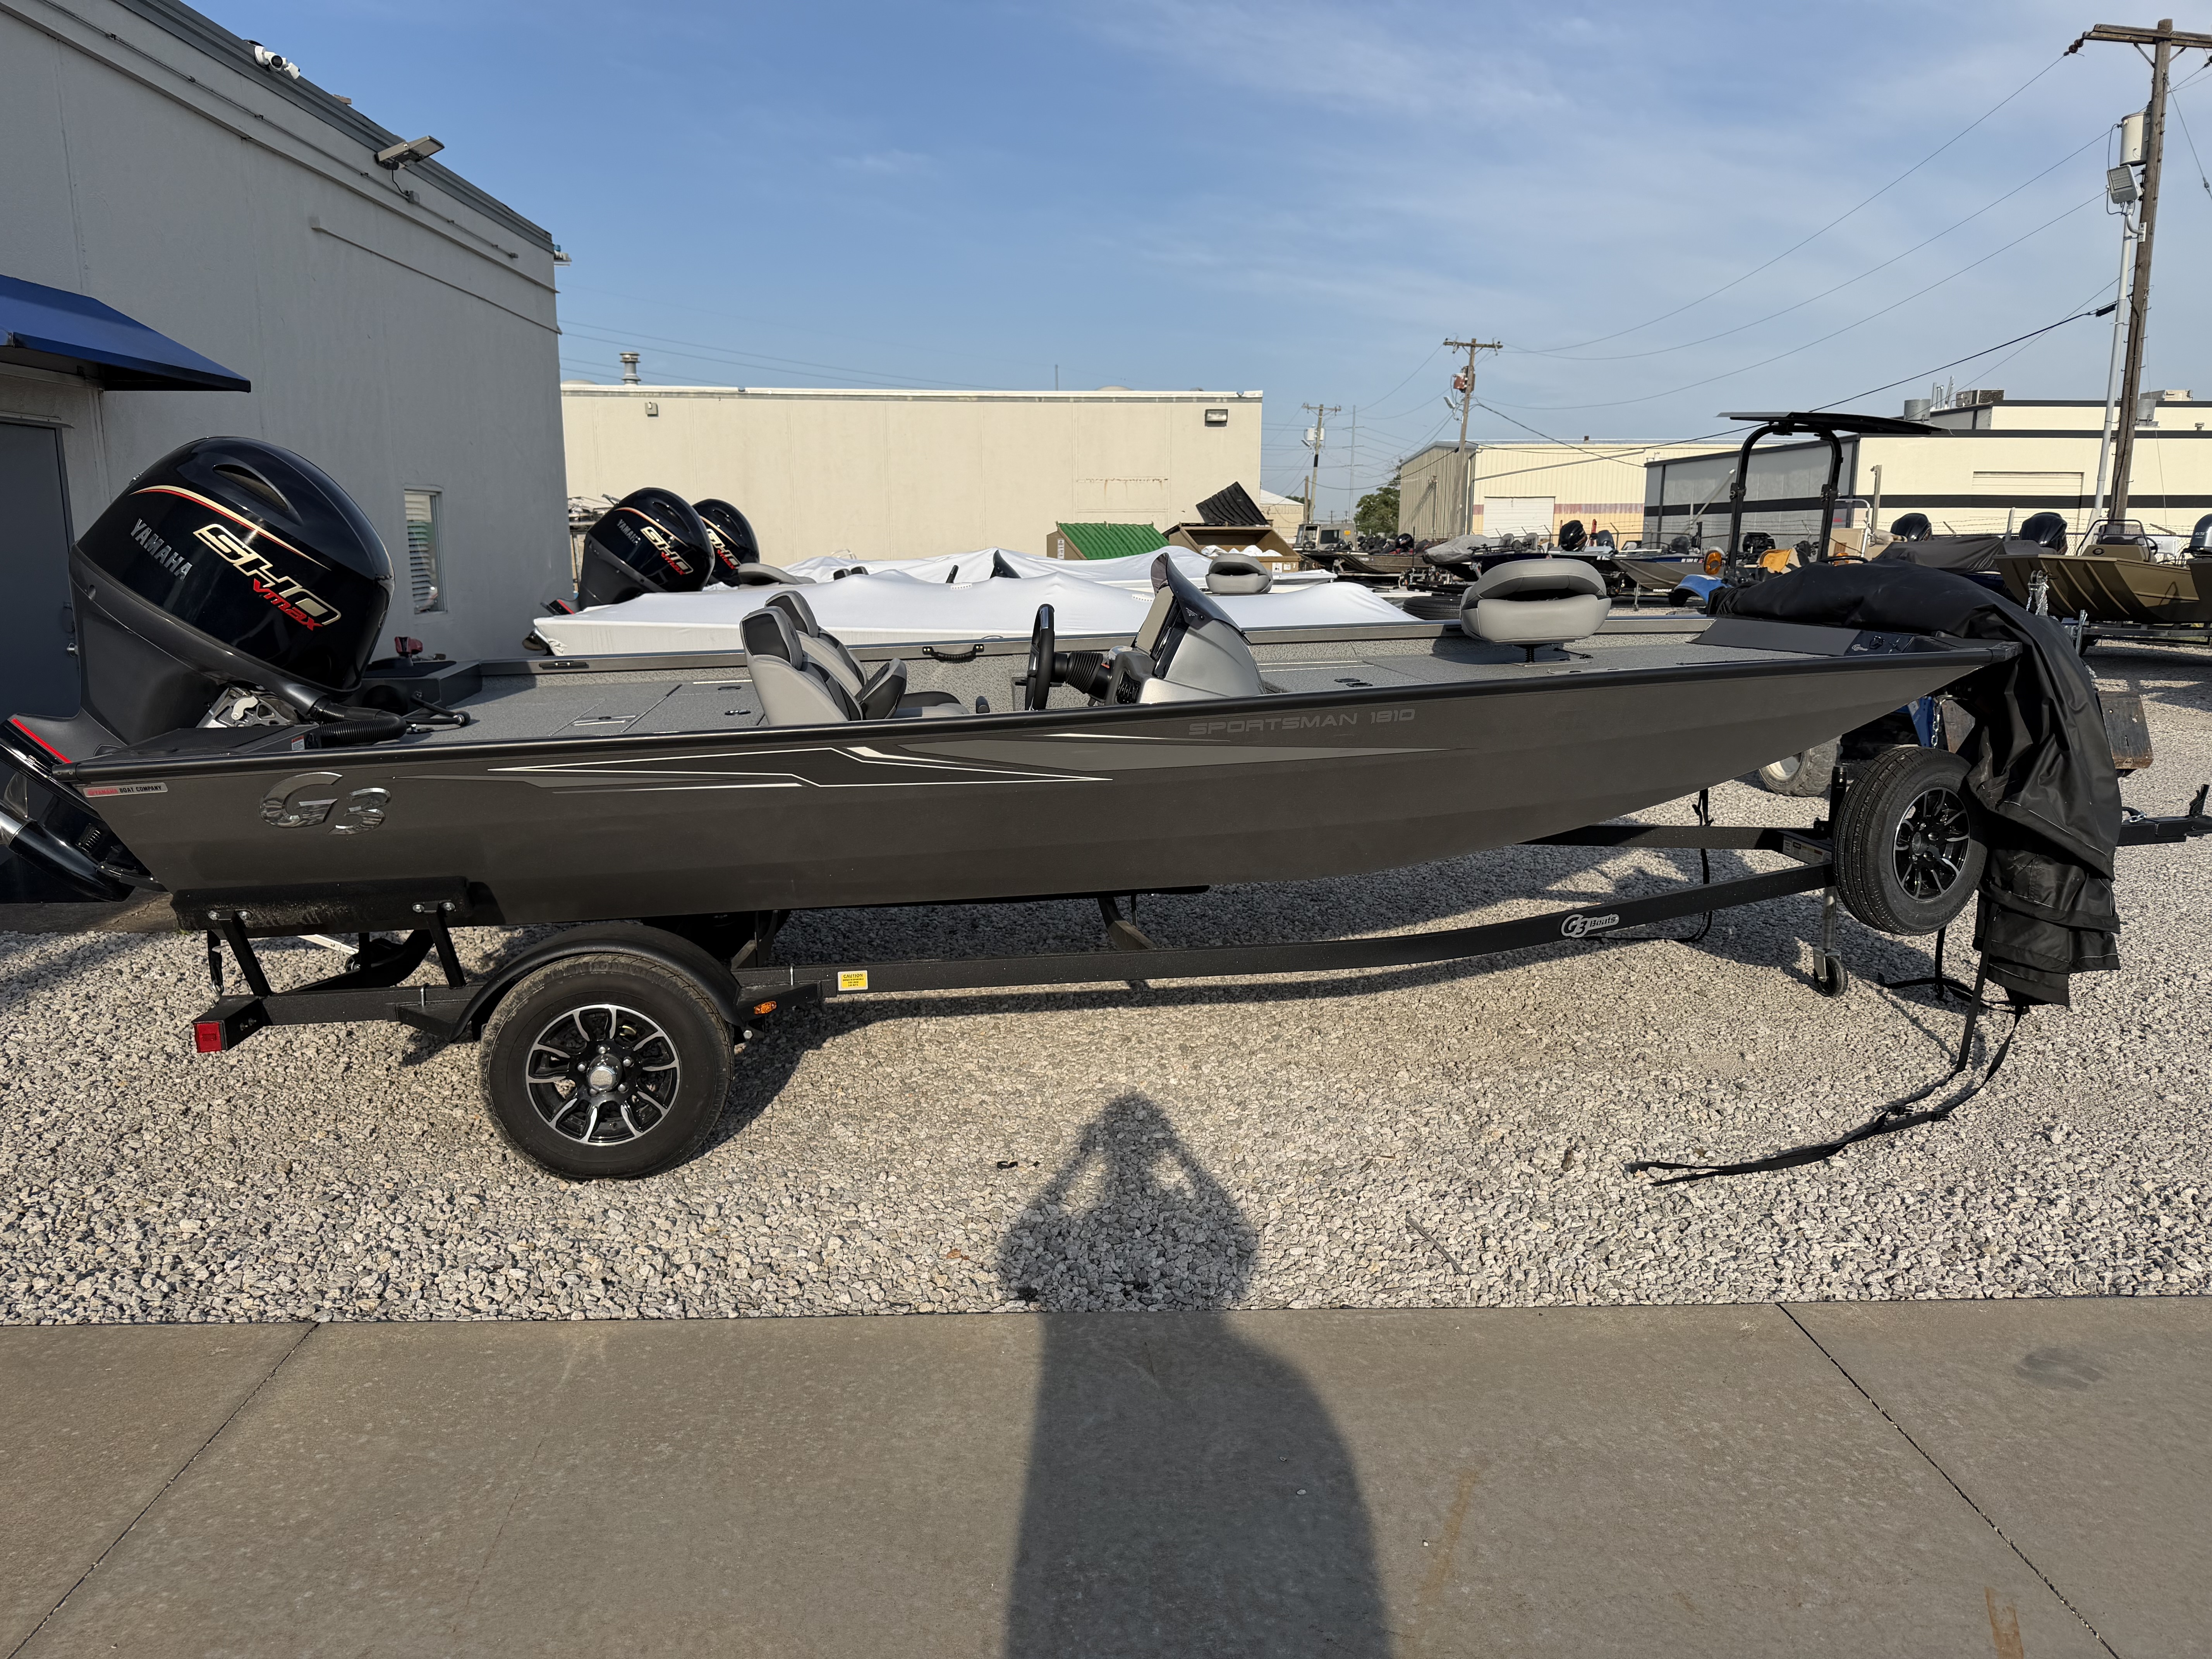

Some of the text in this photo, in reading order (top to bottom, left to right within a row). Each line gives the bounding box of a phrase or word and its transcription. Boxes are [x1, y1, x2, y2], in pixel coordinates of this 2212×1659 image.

[129, 518, 193, 582] YAMAHA
[193, 524, 341, 625] SHO
[640, 526, 694, 574] SHO
[1188, 709, 1415, 735] SPORTSMAN 1810
[259, 771, 392, 835] G3
[1563, 915, 1616, 936] G3 Boats
